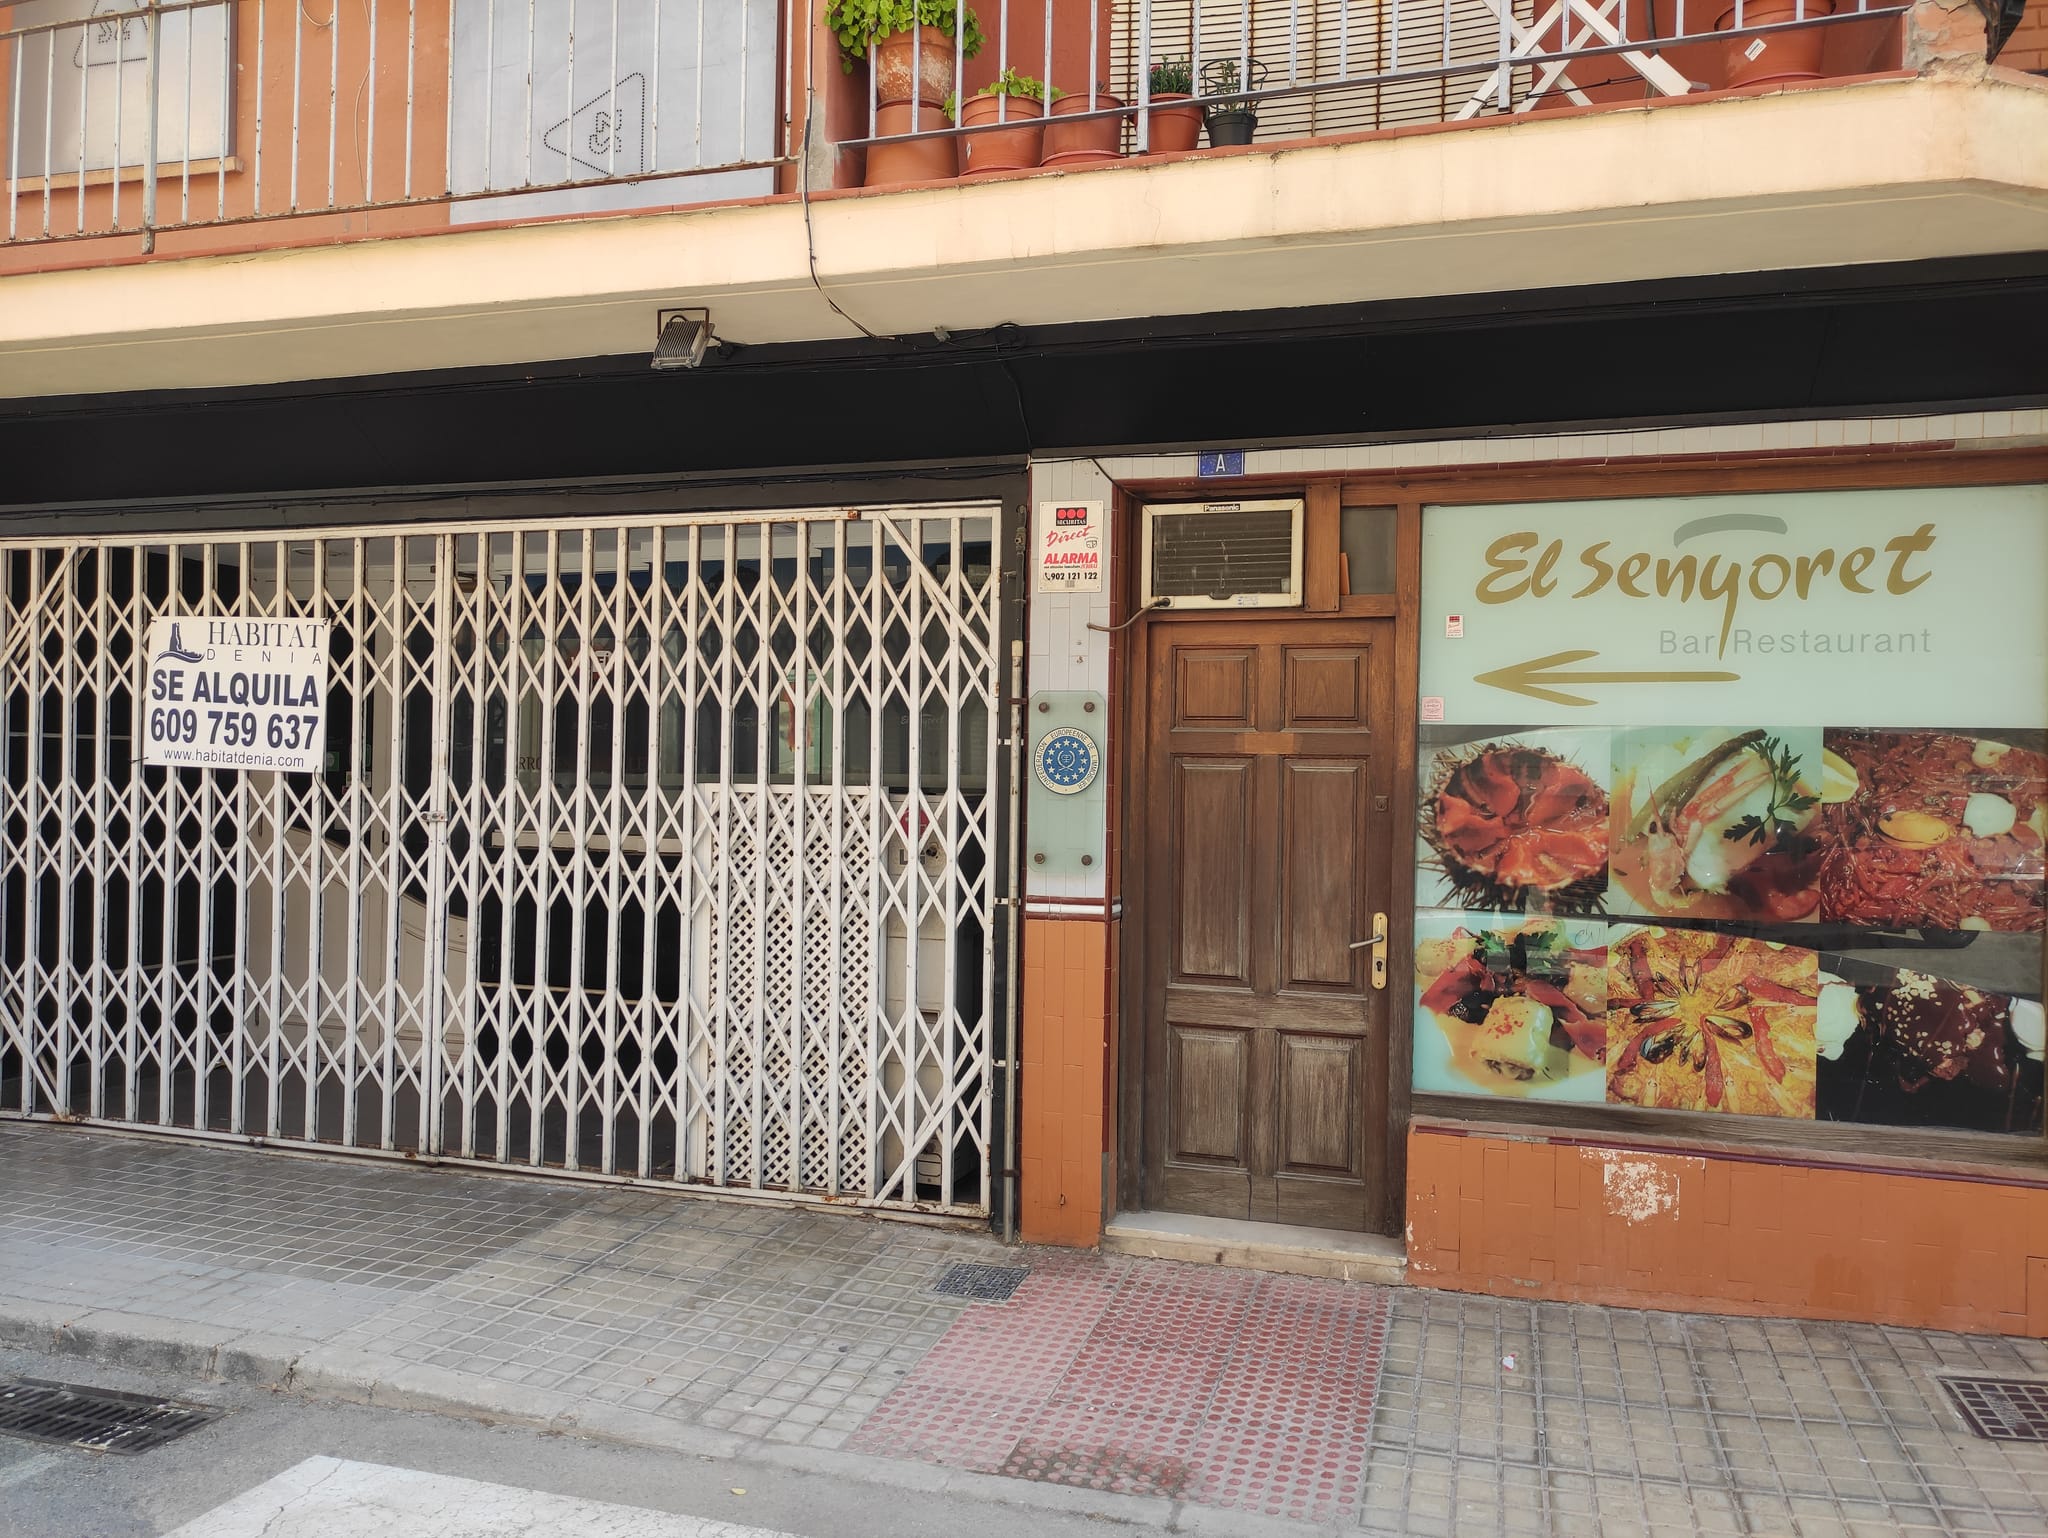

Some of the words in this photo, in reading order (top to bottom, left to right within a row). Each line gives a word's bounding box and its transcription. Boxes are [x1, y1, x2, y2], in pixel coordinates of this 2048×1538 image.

[1215, 454, 1226, 472] A
[1204, 504, 1240, 512] Panasonic
[1046, 525, 1096, 547] Direct
[1044, 552, 1098, 564] ALARMA
[1475, 531, 1564, 605] El
[1051, 572, 1065, 580] 902
[1068, 572, 1080, 580] 121
[1084, 571, 1098, 580] 122
[208, 621, 325, 648] HABITAT
[1659, 630, 1716, 654] Bar
[1733, 629, 1932, 654] Restaurant
[206, 648, 322, 664] DENIA
[151, 669, 185, 701] SE
[192, 671, 319, 707] ALQUILA
[151, 707, 197, 743] 609
[207, 711, 257, 747] 759
[267, 713, 319, 750] 637
[164, 749, 304, 767] www.habitatdenia.com
